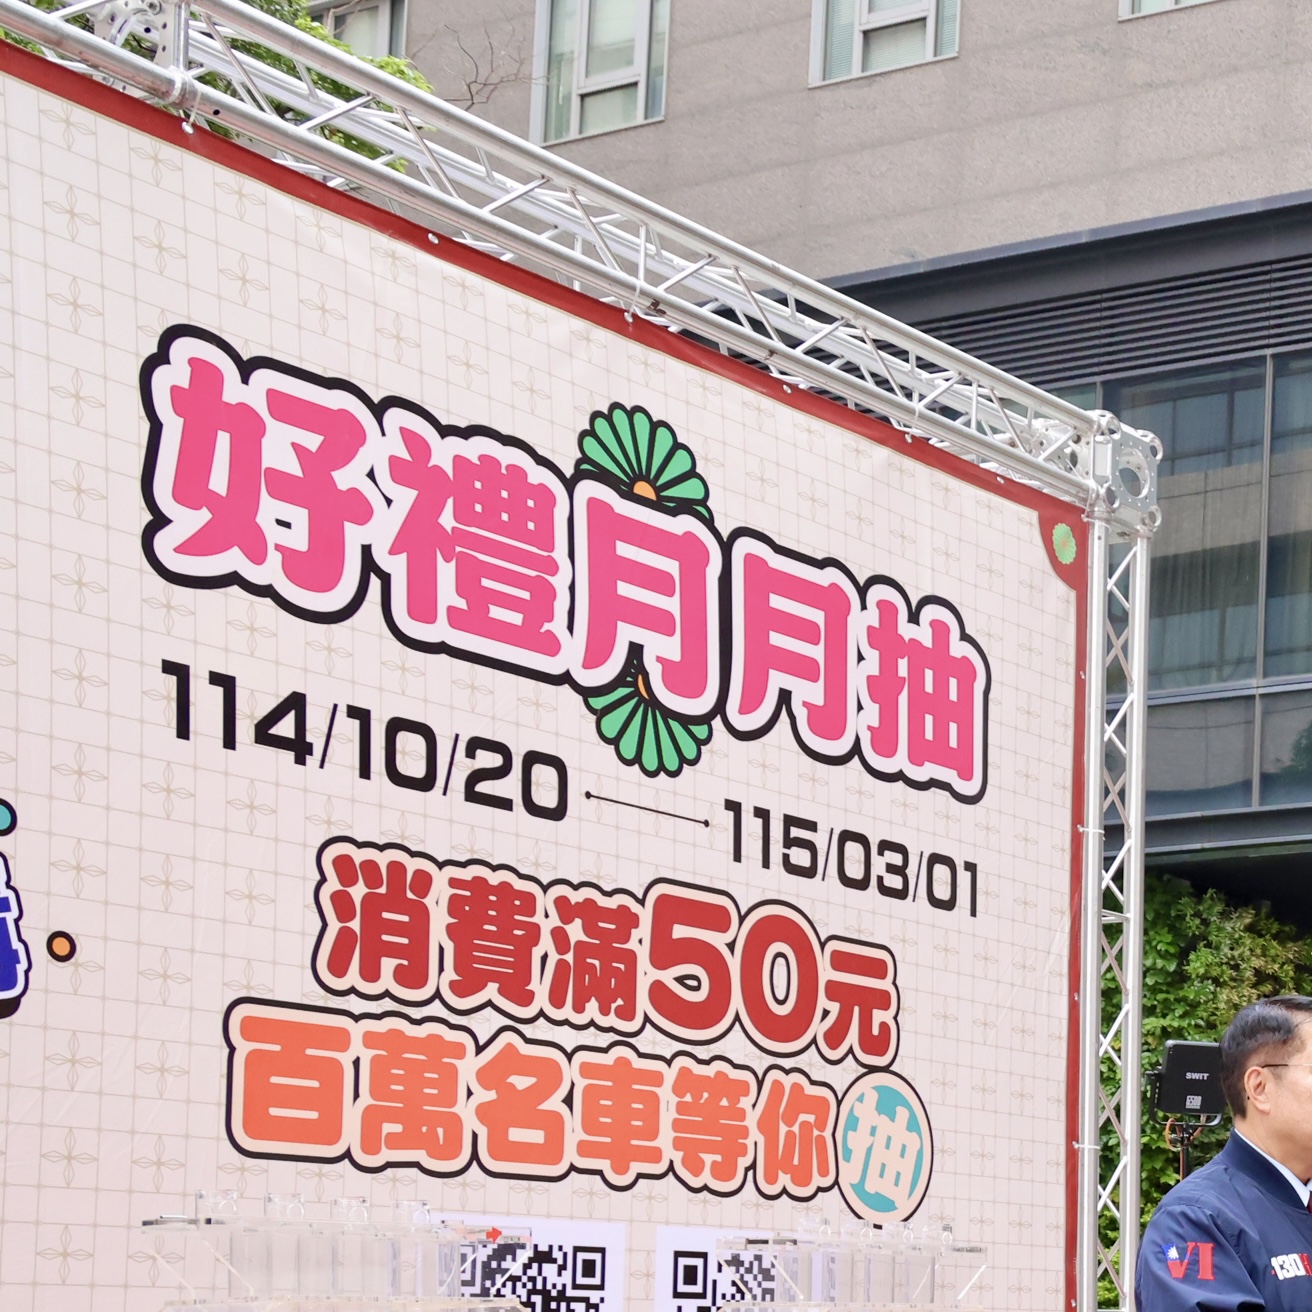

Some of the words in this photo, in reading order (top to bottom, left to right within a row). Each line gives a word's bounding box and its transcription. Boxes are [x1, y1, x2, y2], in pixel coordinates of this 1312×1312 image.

[155, 342, 985, 792] 好禮月月抽
[162, 659, 569, 823] 114/10/20
[724, 798, 980, 917] 115/03/01
[326, 850, 896, 1062] 消費滿50元
[1185, 1072, 1209, 1080] SWIT
